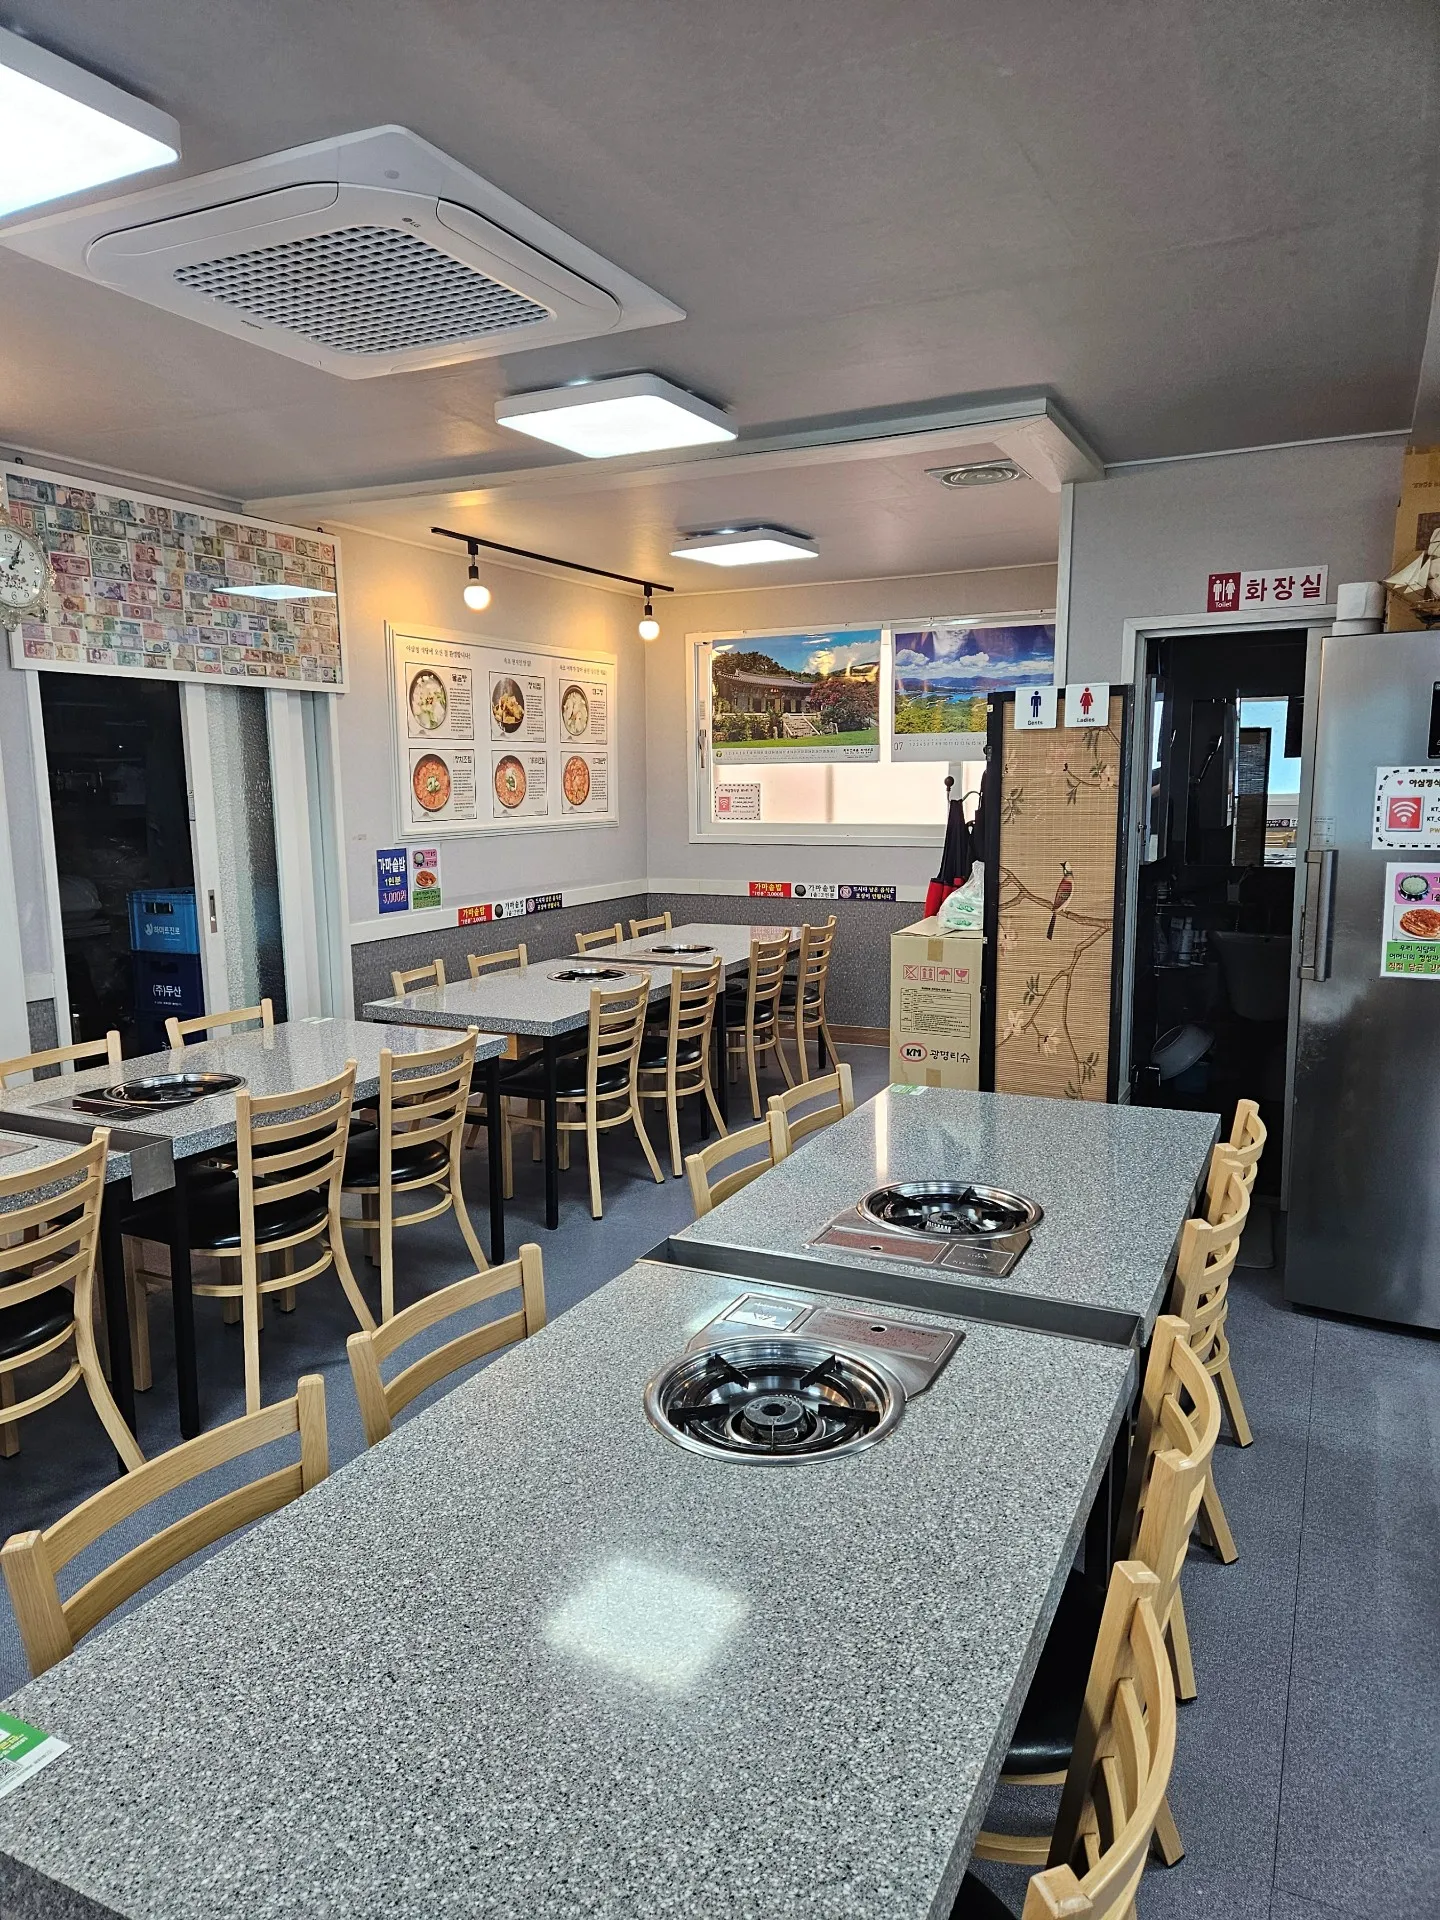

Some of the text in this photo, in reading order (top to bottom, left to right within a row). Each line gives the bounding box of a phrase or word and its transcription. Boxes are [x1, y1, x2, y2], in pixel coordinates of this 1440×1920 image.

[4, 533, 12, 543] 12
[29, 551, 35, 561] 2
[1245, 573, 1322, 601] 화장실
[11, 591, 17, 601] 6
[24, 589, 30, 598] 5
[893, 742, 903, 750] 07
[378, 856, 405, 874] 가마솥밥
[385, 876, 401, 886] 1인분
[754, 883, 782, 891] 가마솥밥
[808, 884, 835, 892] 가마솥밥
[504, 899, 524, 909] 가마솥밥
[462, 906, 485, 917] 가마솥밥
[153, 926, 180, 935] 하이트진로
[1416, 945, 1436, 953] 식당의
[1419, 954, 1439, 962] 정성과
[1389, 962, 1404, 970] 직접
[1409, 963, 1424, 971] 담근
[153, 984, 182, 997] (주)두산
[906, 1048, 922, 1057] KM
[930, 1049, 970, 1064] 광명티슈
